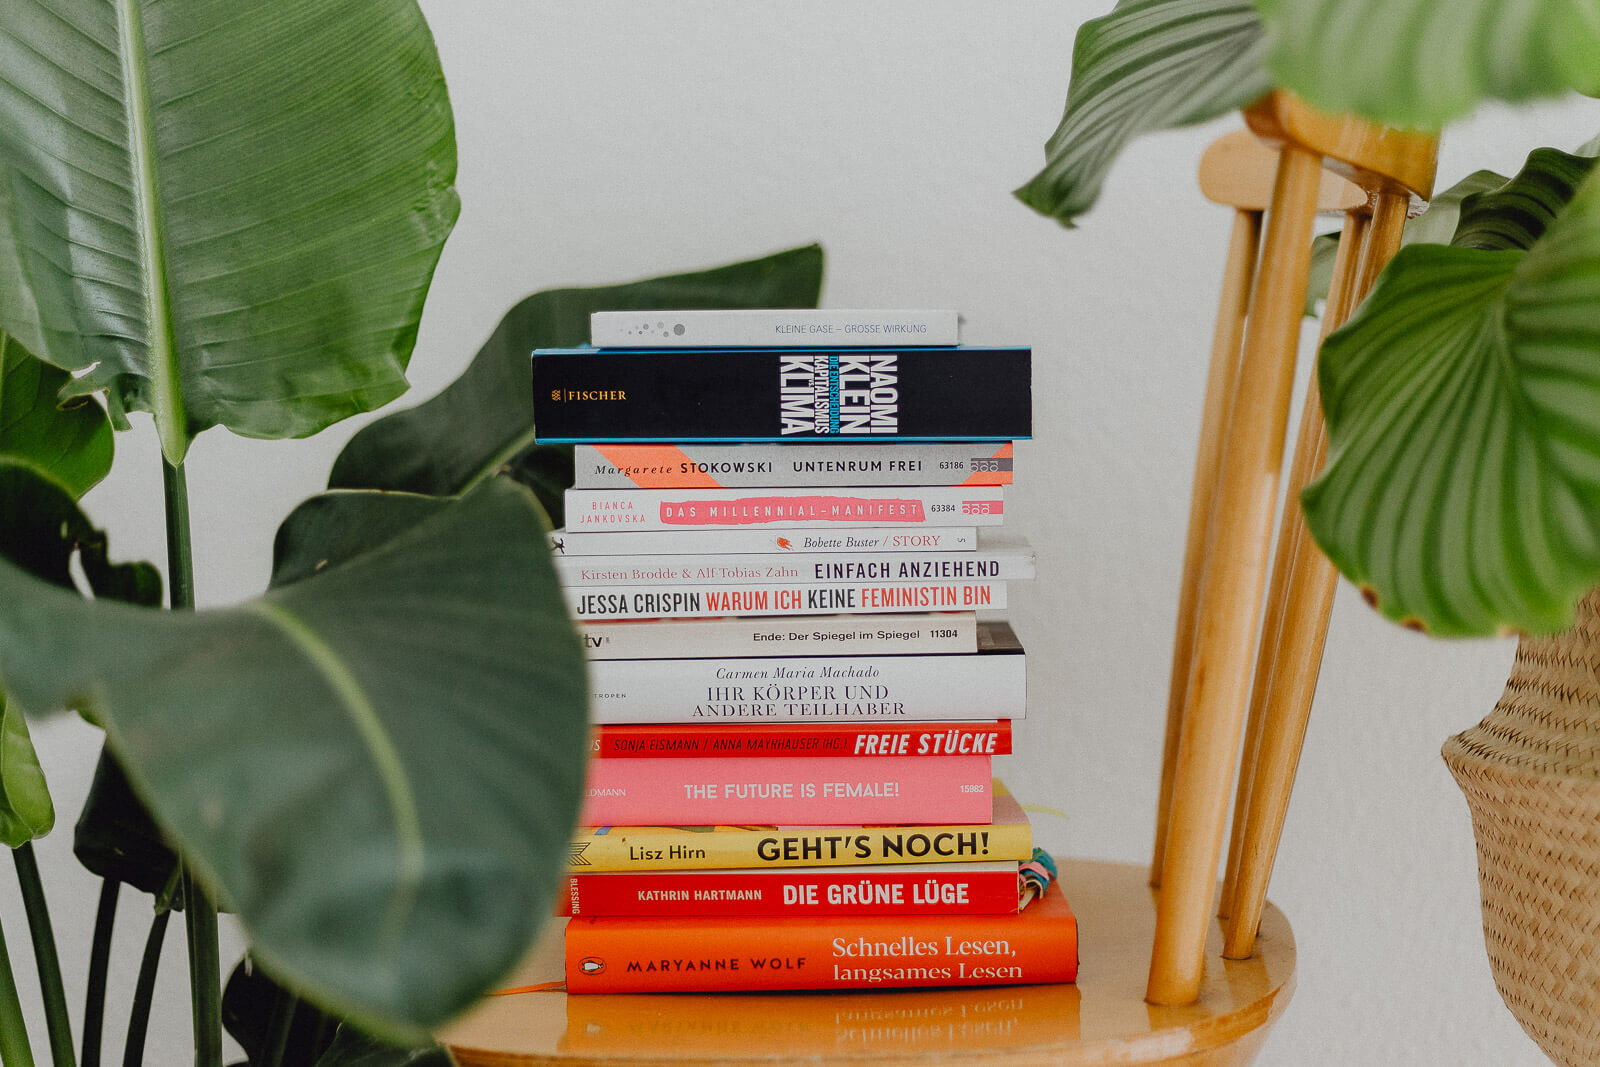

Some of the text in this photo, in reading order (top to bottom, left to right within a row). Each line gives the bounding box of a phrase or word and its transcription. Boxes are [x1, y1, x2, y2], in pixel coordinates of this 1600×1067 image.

[775, 324, 806, 334] KLEINE
[809, 324, 833, 334] GASE
[844, 324, 881, 334] GROSSE
[883, 324, 927, 334] WIRKUNG
[568, 390, 627, 401] FISCHER
[780, 355, 814, 435] KLIMA
[814, 355, 829, 434] KAPITALISMUS
[829, 355, 839, 434] DIE ENTSCHEIDUNG
[839, 355, 870, 434] KLEIN
[870, 355, 898, 434] NAOMI
[595, 460, 922, 476] Margarete STOKOWSKI UNTENRUM FREI
[939, 461, 963, 470] 63186
[592, 501, 633, 511] BIANCA
[666, 503, 917, 517] DAS MILLENNIAL-MANIFEST
[931, 504, 955, 513] 63384
[580, 514, 646, 524] JANKOVSKA
[804, 537, 842, 548] Bobette
[845, 536, 879, 548] Buster
[892, 536, 941, 547] STORY
[581, 569, 628, 581] Kirsten
[632, 568, 677, 579] Brodde
[682, 568, 691, 579] &
[765, 565, 799, 577] Zahn
[815, 560, 1000, 579] EINFACH ANZIEHEND
[576, 585, 991, 615] JESSA CRISPIN WARUM ICH KEINE FEMINISTIN BIN
[753, 629, 920, 644] Ende: Der Spiegel im Spiegel
[929, 629, 959, 638] 11304
[716, 665, 880, 680] Carmen Maria Machado
[707, 683, 889, 701] IHR KÖRPER UND
[692, 702, 906, 718] ANDERE TEILHABER
[614, 739, 646, 752] SONJA
[649, 738, 700, 751] EISMANN
[712, 738, 743, 751] ANNA
[747, 737, 820, 751] MAYRHAUSER
[821, 736, 849, 751] (HG.)
[853, 730, 998, 755] FREIE STÜCKE
[684, 782, 900, 799] THE FUTURE IS FEMALE!
[882, 831, 990, 858] NOCH!
[629, 845, 706, 861] Lisz Hirn
[570, 878, 580, 915] BLESSING
[637, 889, 762, 901] KATHRIN HARTMANN
[783, 879, 969, 905] DIE GRÜNE LÜGE
[832, 936, 1016, 957] Schnelles Lesen,
[627, 957, 807, 972] MARYANNE WOLF
[834, 962, 1023, 983] langsames Lesen
